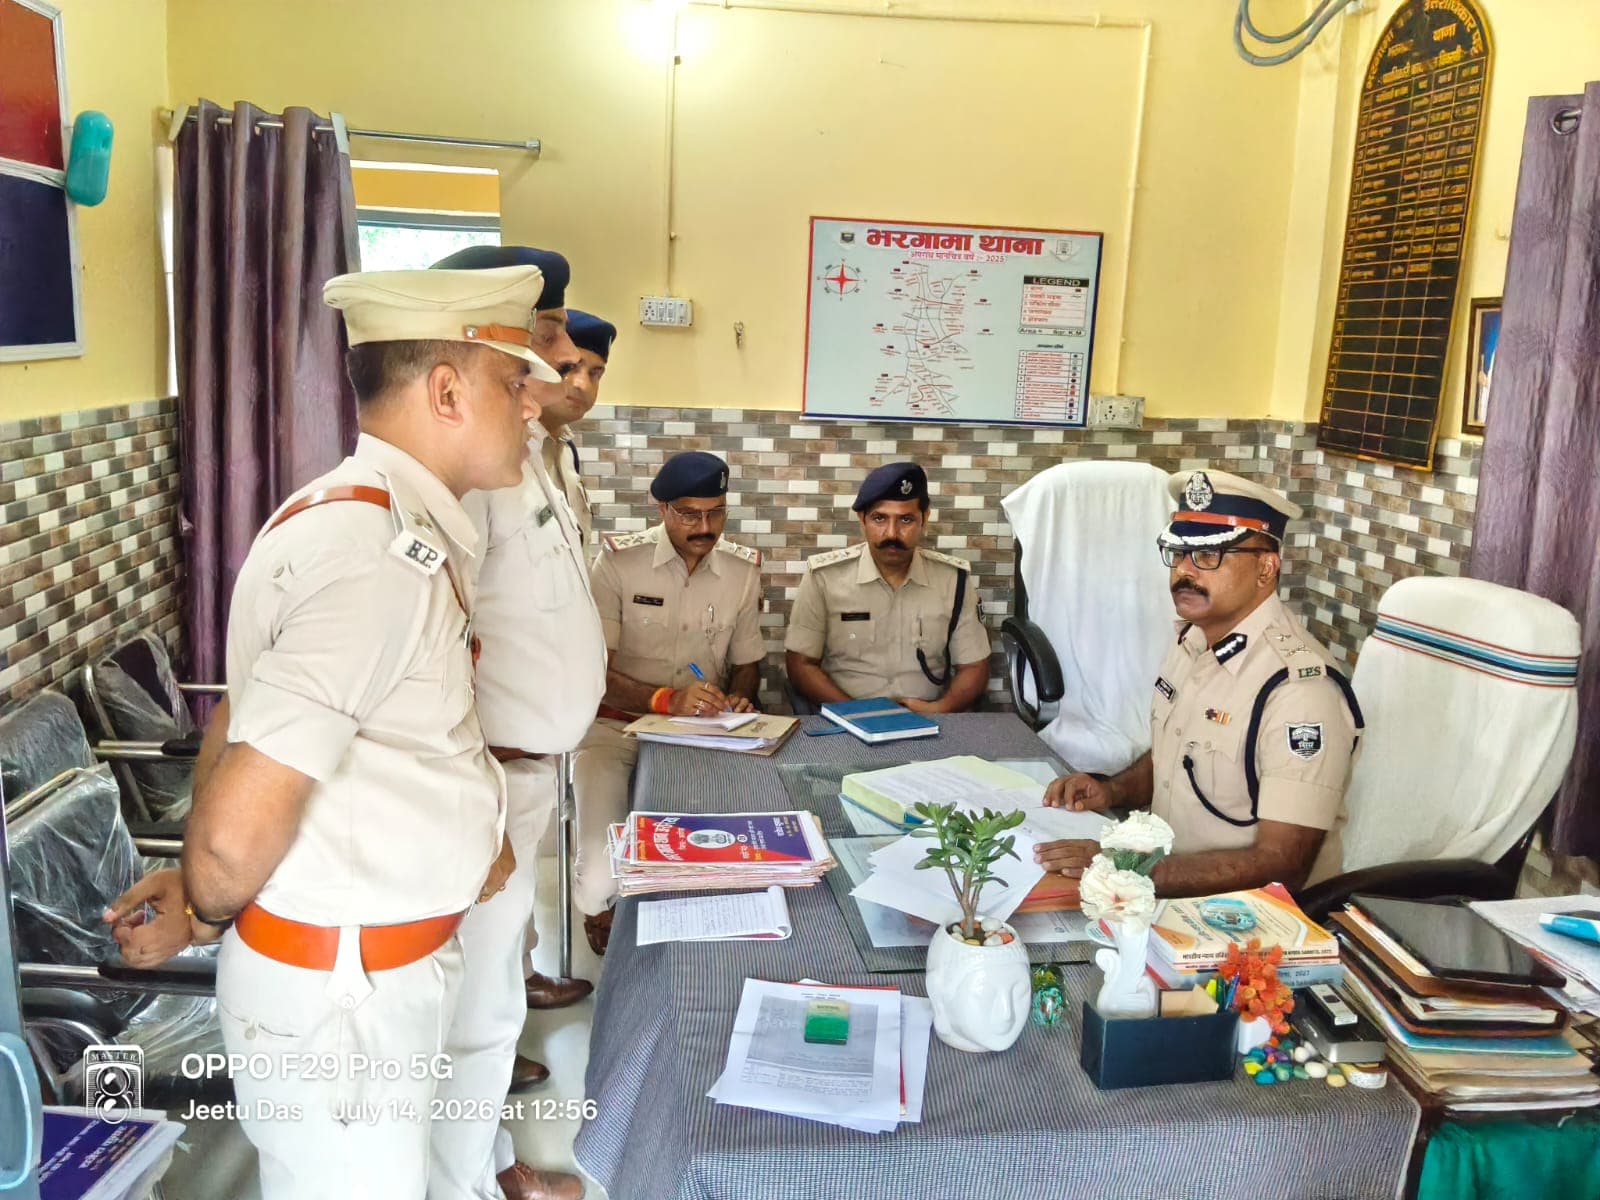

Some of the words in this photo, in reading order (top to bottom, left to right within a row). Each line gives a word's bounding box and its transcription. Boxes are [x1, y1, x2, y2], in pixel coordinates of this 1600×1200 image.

[867, 229, 974, 251] भरगामा
[979, 235, 1045, 255] थाना
[1033, 277, 1081, 286] LEGEND
